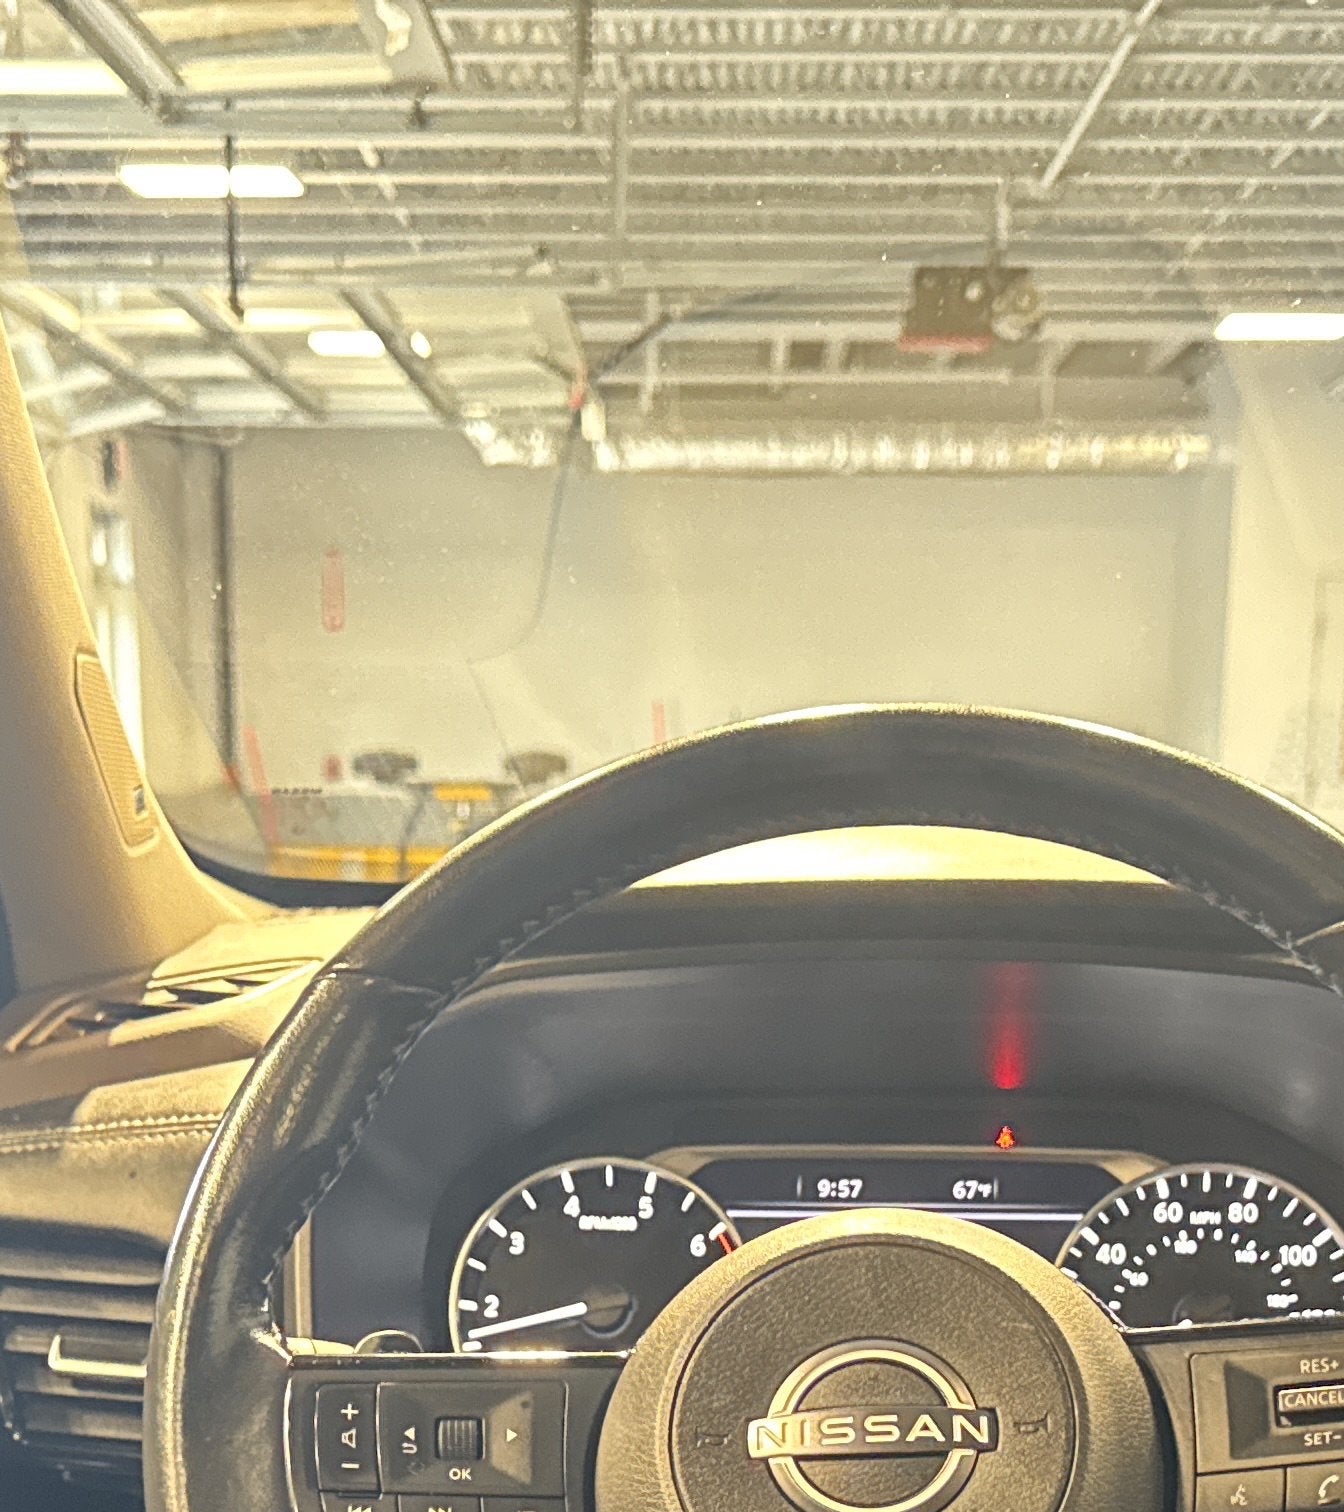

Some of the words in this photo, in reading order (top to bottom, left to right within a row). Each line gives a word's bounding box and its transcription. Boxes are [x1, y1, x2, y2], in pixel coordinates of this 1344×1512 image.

[816, 1178, 863, 1198] 9:57
[563, 1195, 581, 1218] 4
[638, 1195, 654, 1219] 5
[1153, 1201, 1184, 1223] 60
[1227, 1201, 1259, 1224] 80
[509, 1230, 525, 1255] 3
[690, 1233, 707, 1258] 6
[1095, 1242, 1127, 1265] 40
[1278, 1244, 1318, 1267] 100
[483, 1294, 500, 1318] 2
[1300, 1357, 1340, 1374] RES+
[756, 1413, 990, 1451] NISSAN
[448, 1467, 472, 1482] OK
